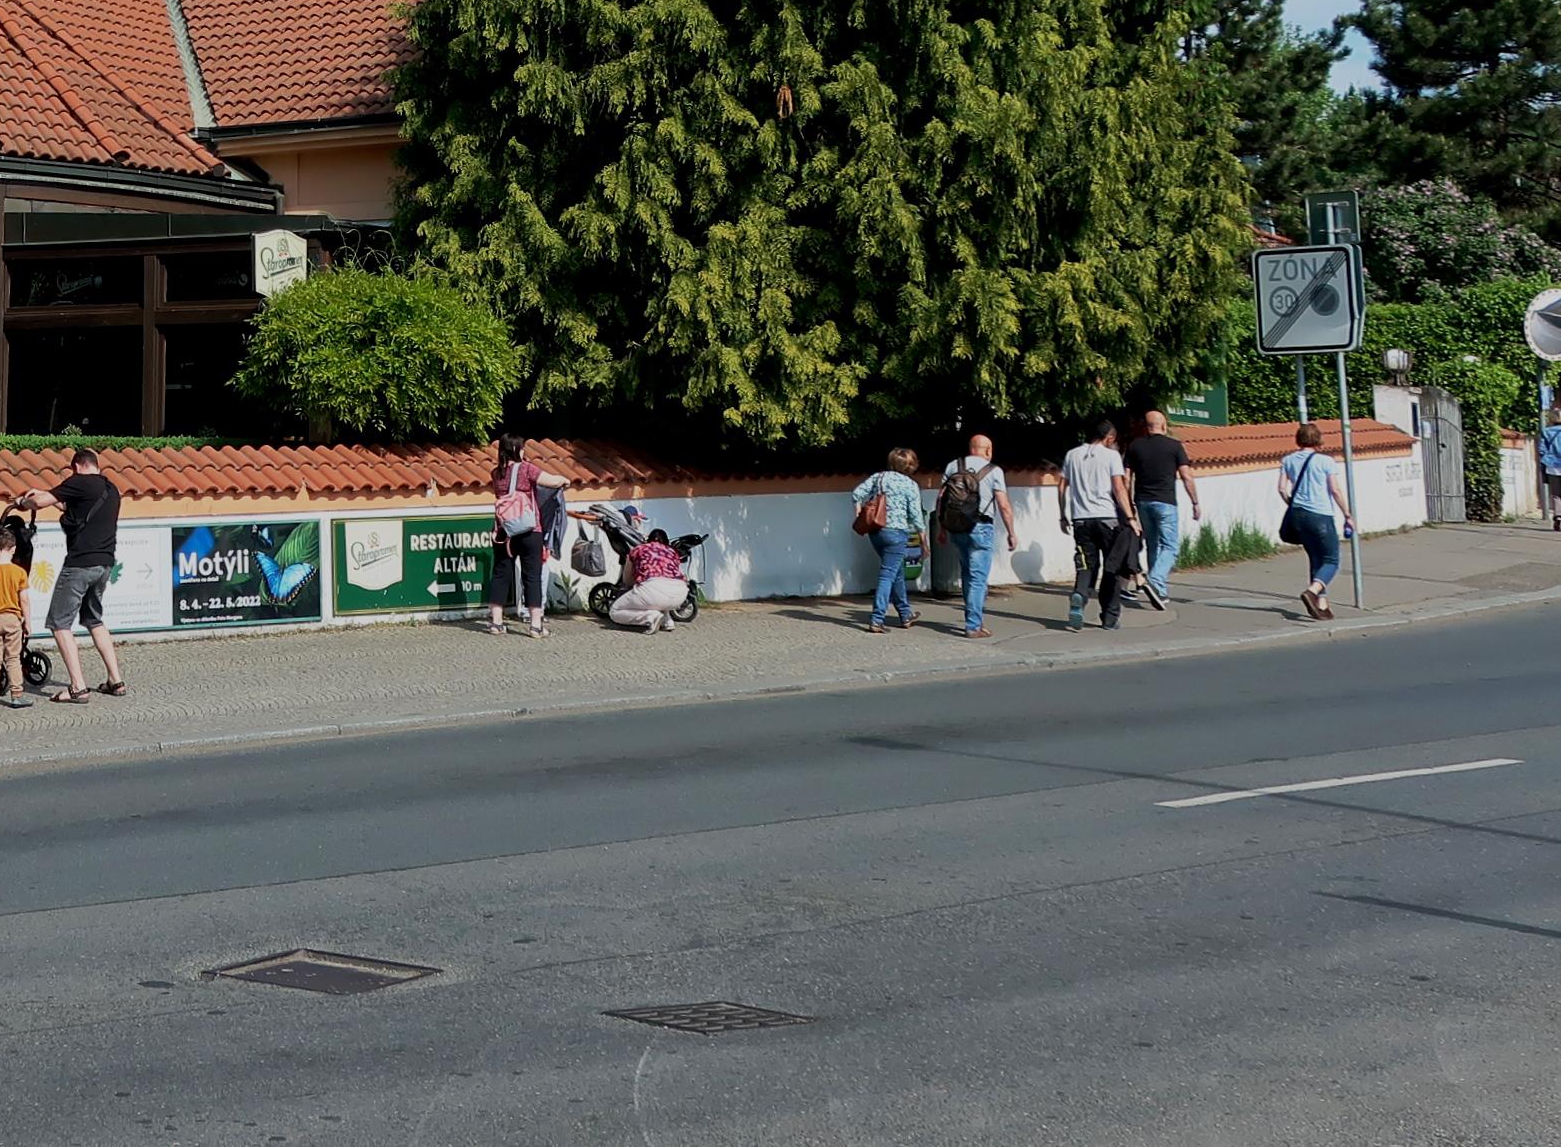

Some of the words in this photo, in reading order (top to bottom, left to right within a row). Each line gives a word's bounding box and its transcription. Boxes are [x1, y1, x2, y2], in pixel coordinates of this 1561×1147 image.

[1267, 254, 1338, 282] ZÓNA
[1274, 294, 1294, 310] 30
[179, 548, 250, 582] Motýli
[351, 541, 399, 571] Staropramen
[434, 552, 477, 574] ALTÁN
[461, 580, 472, 592] 10
[473, 583, 483, 592] m
